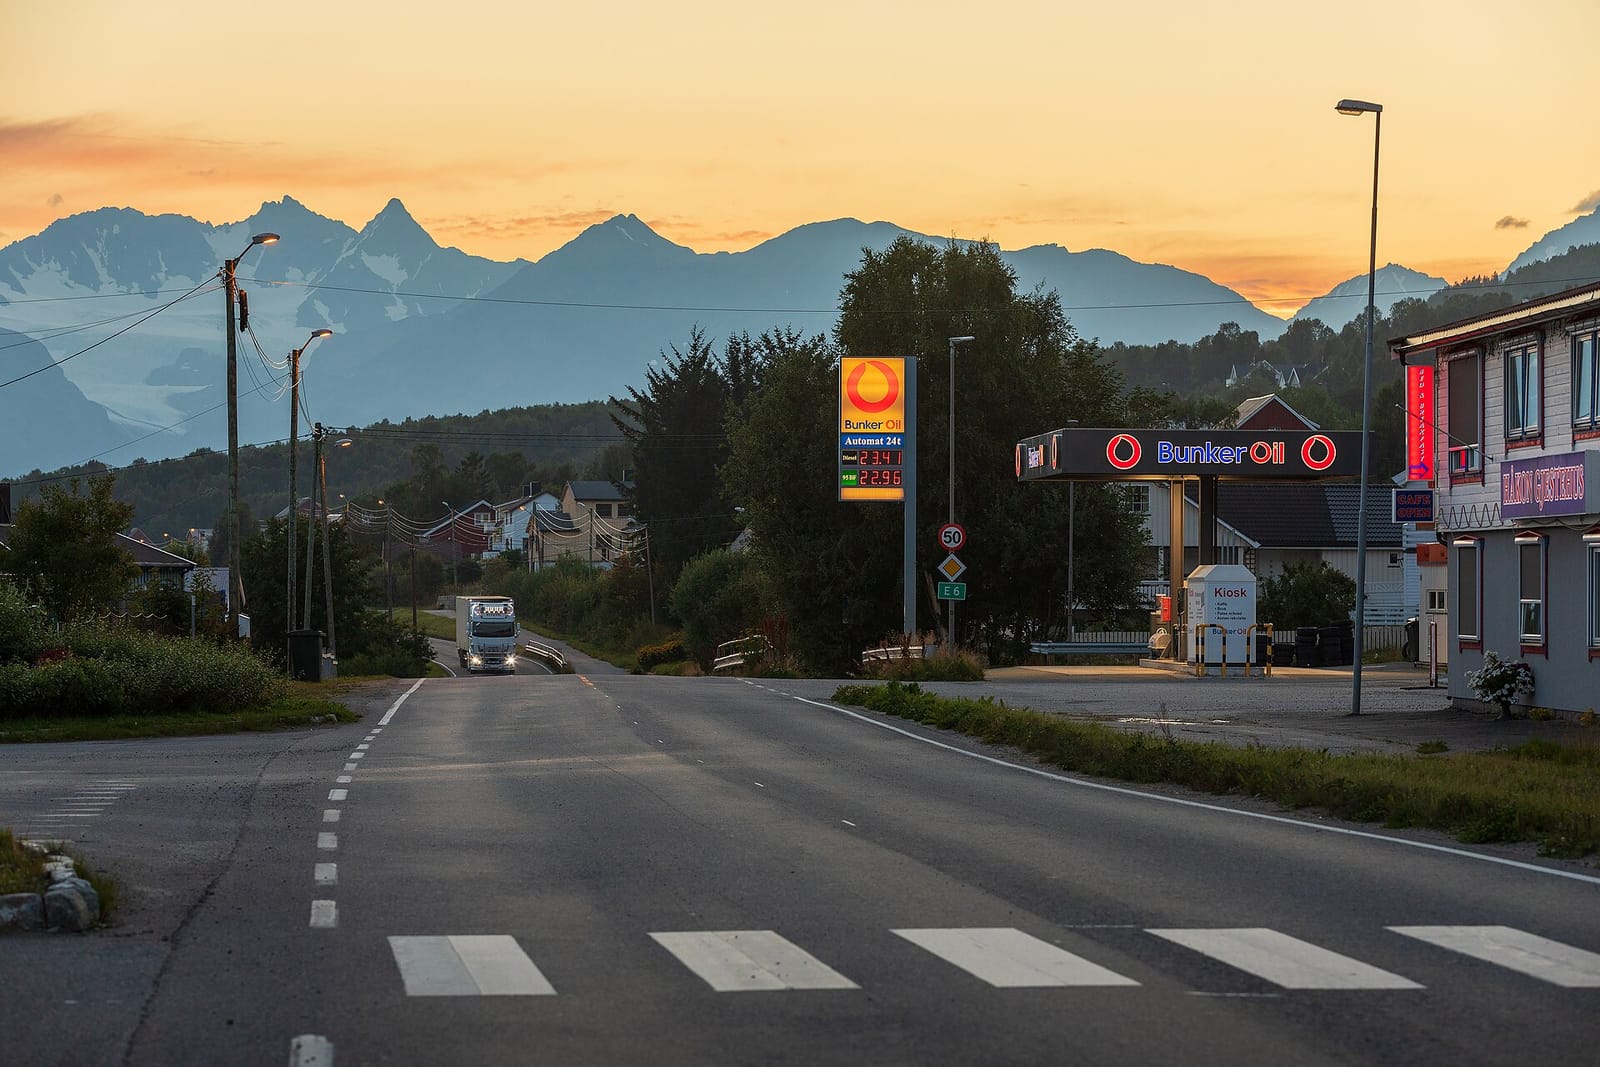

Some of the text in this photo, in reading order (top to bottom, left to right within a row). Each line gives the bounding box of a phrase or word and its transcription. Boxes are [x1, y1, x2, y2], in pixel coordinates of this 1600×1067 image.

[844, 419, 901, 430] Bunker Oil
[844, 436, 902, 446] Automat 24t
[860, 451, 902, 465] 23.41
[1157, 441, 1286, 465] Bunker Oil
[860, 470, 901, 485] 22.96
[1502, 463, 1585, 511] HÅKON GJESTEHUS
[1397, 508, 1431, 518] OPEN
[943, 531, 962, 544] 50
[1214, 587, 1247, 598] Kiosk
